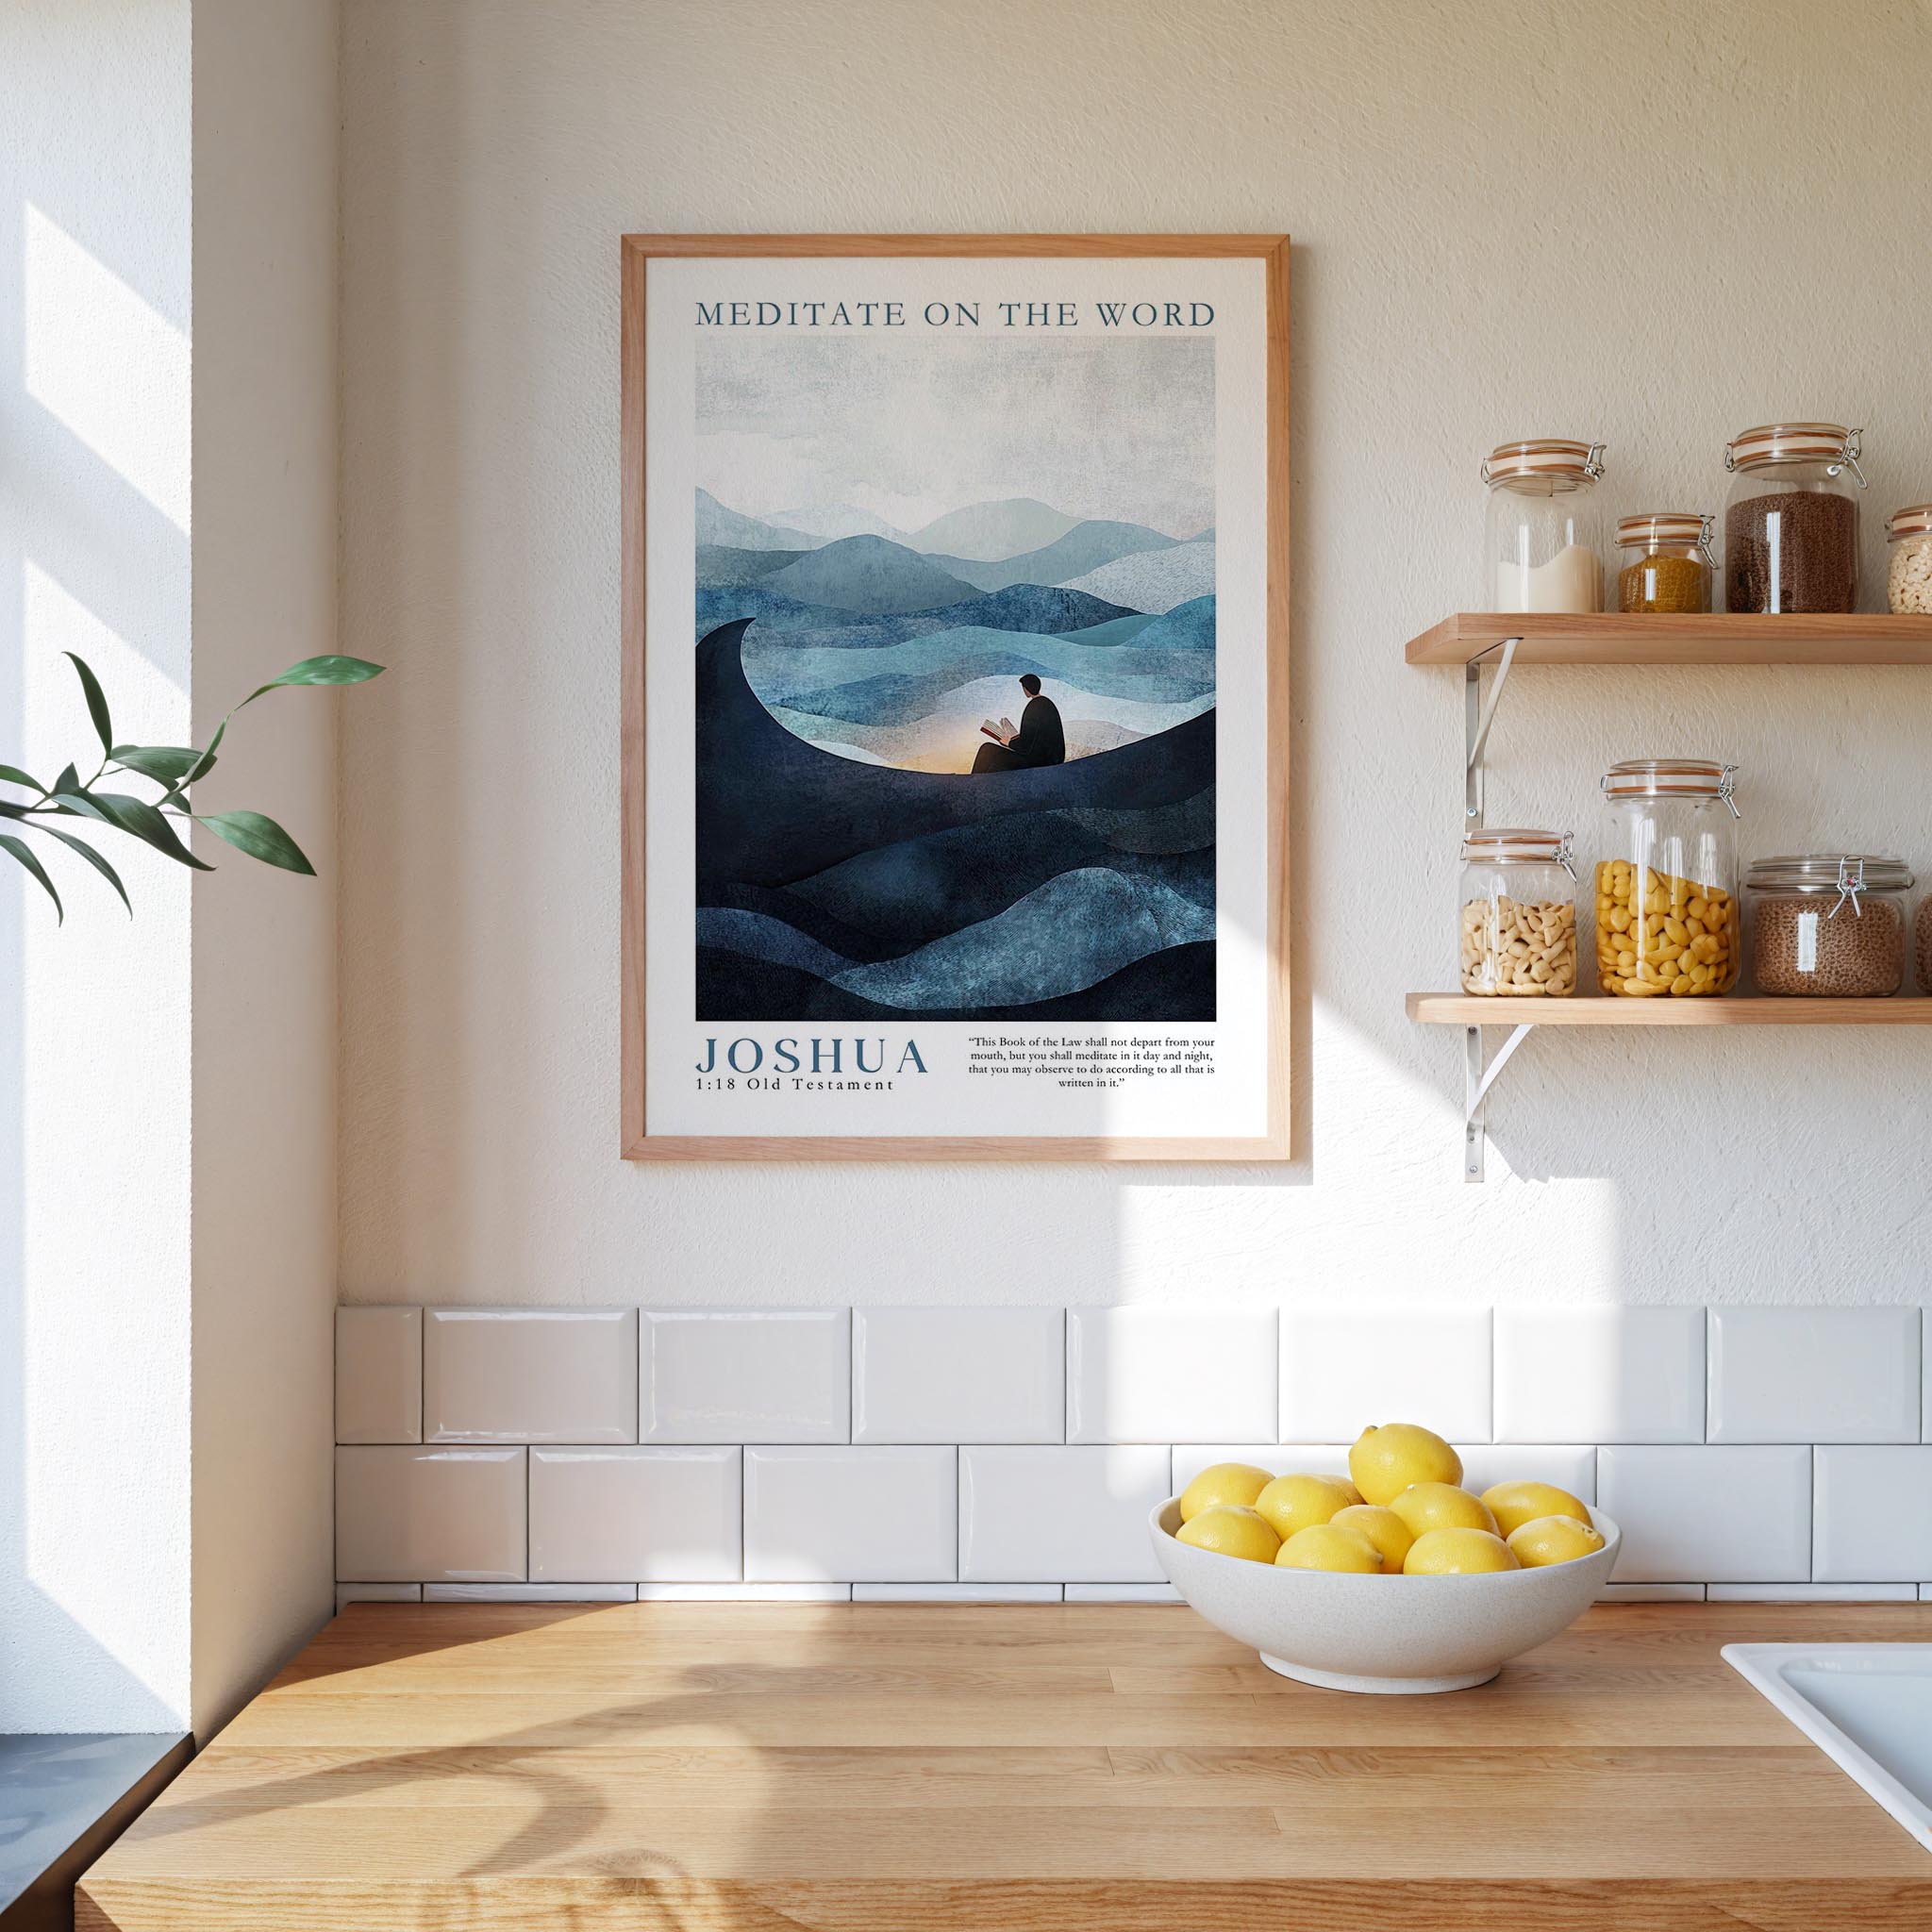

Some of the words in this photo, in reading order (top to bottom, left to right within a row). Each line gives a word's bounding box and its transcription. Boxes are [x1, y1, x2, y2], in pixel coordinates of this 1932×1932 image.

[695, 302, 907, 326] MEDITATE
[924, 302, 981, 327] ON
[999, 302, 1079, 327] THE
[1095, 302, 1215, 327] WORD
[969, 1037, 996, 1046] “This
[1000, 1037, 1025, 1046] Book
[1029, 1037, 1041, 1046] of
[1043, 1037, 1058, 1046] the
[1061, 1037, 1082, 1046] Law
[1085, 1037, 1108, 1046] shall
[1130, 1037, 1161, 1049] depart
[1165, 1037, 1189, 1046] from
[1192, 1040, 1215, 1049] your
[695, 1038, 928, 1074] JOSHUA
[971, 1051, 1007, 1061] mouth,
[1009, 1051, 1025, 1060] but
[1028, 1053, 1047, 1062] you
[1050, 1051, 1072, 1060] shall
[1075, 1051, 1117, 1060] meditate
[1121, 1051, 1130, 1060] in
[1134, 1051, 1141, 1060] it
[1143, 1051, 1160, 1062] day
[1163, 1051, 1181, 1060] and
[1185, 1051, 1213, 1062] night,
[969, 1064, 988, 1074] that
[991, 1066, 1008, 1076] you
[1012, 1066, 1032, 1076] may
[1035, 1064, 1074, 1074] observe
[1076, 1065, 1087, 1074] to
[1090, 1064, 1103, 1074] do
[1106, 1064, 1154, 1076] according
[1158, 1065, 1168, 1074] to
[1170, 1064, 1181, 1074] all
[1185, 1064, 1204, 1074] that
[1208, 1064, 1215, 1074] is
[696, 1077, 736, 1091] 1:18
[747, 1077, 781, 1091] Old
[791, 1077, 893, 1091] Testament
[1058, 1078, 1093, 1087] written
[1096, 1078, 1106, 1087] in
[1109, 1078, 1124, 1087] it.”
